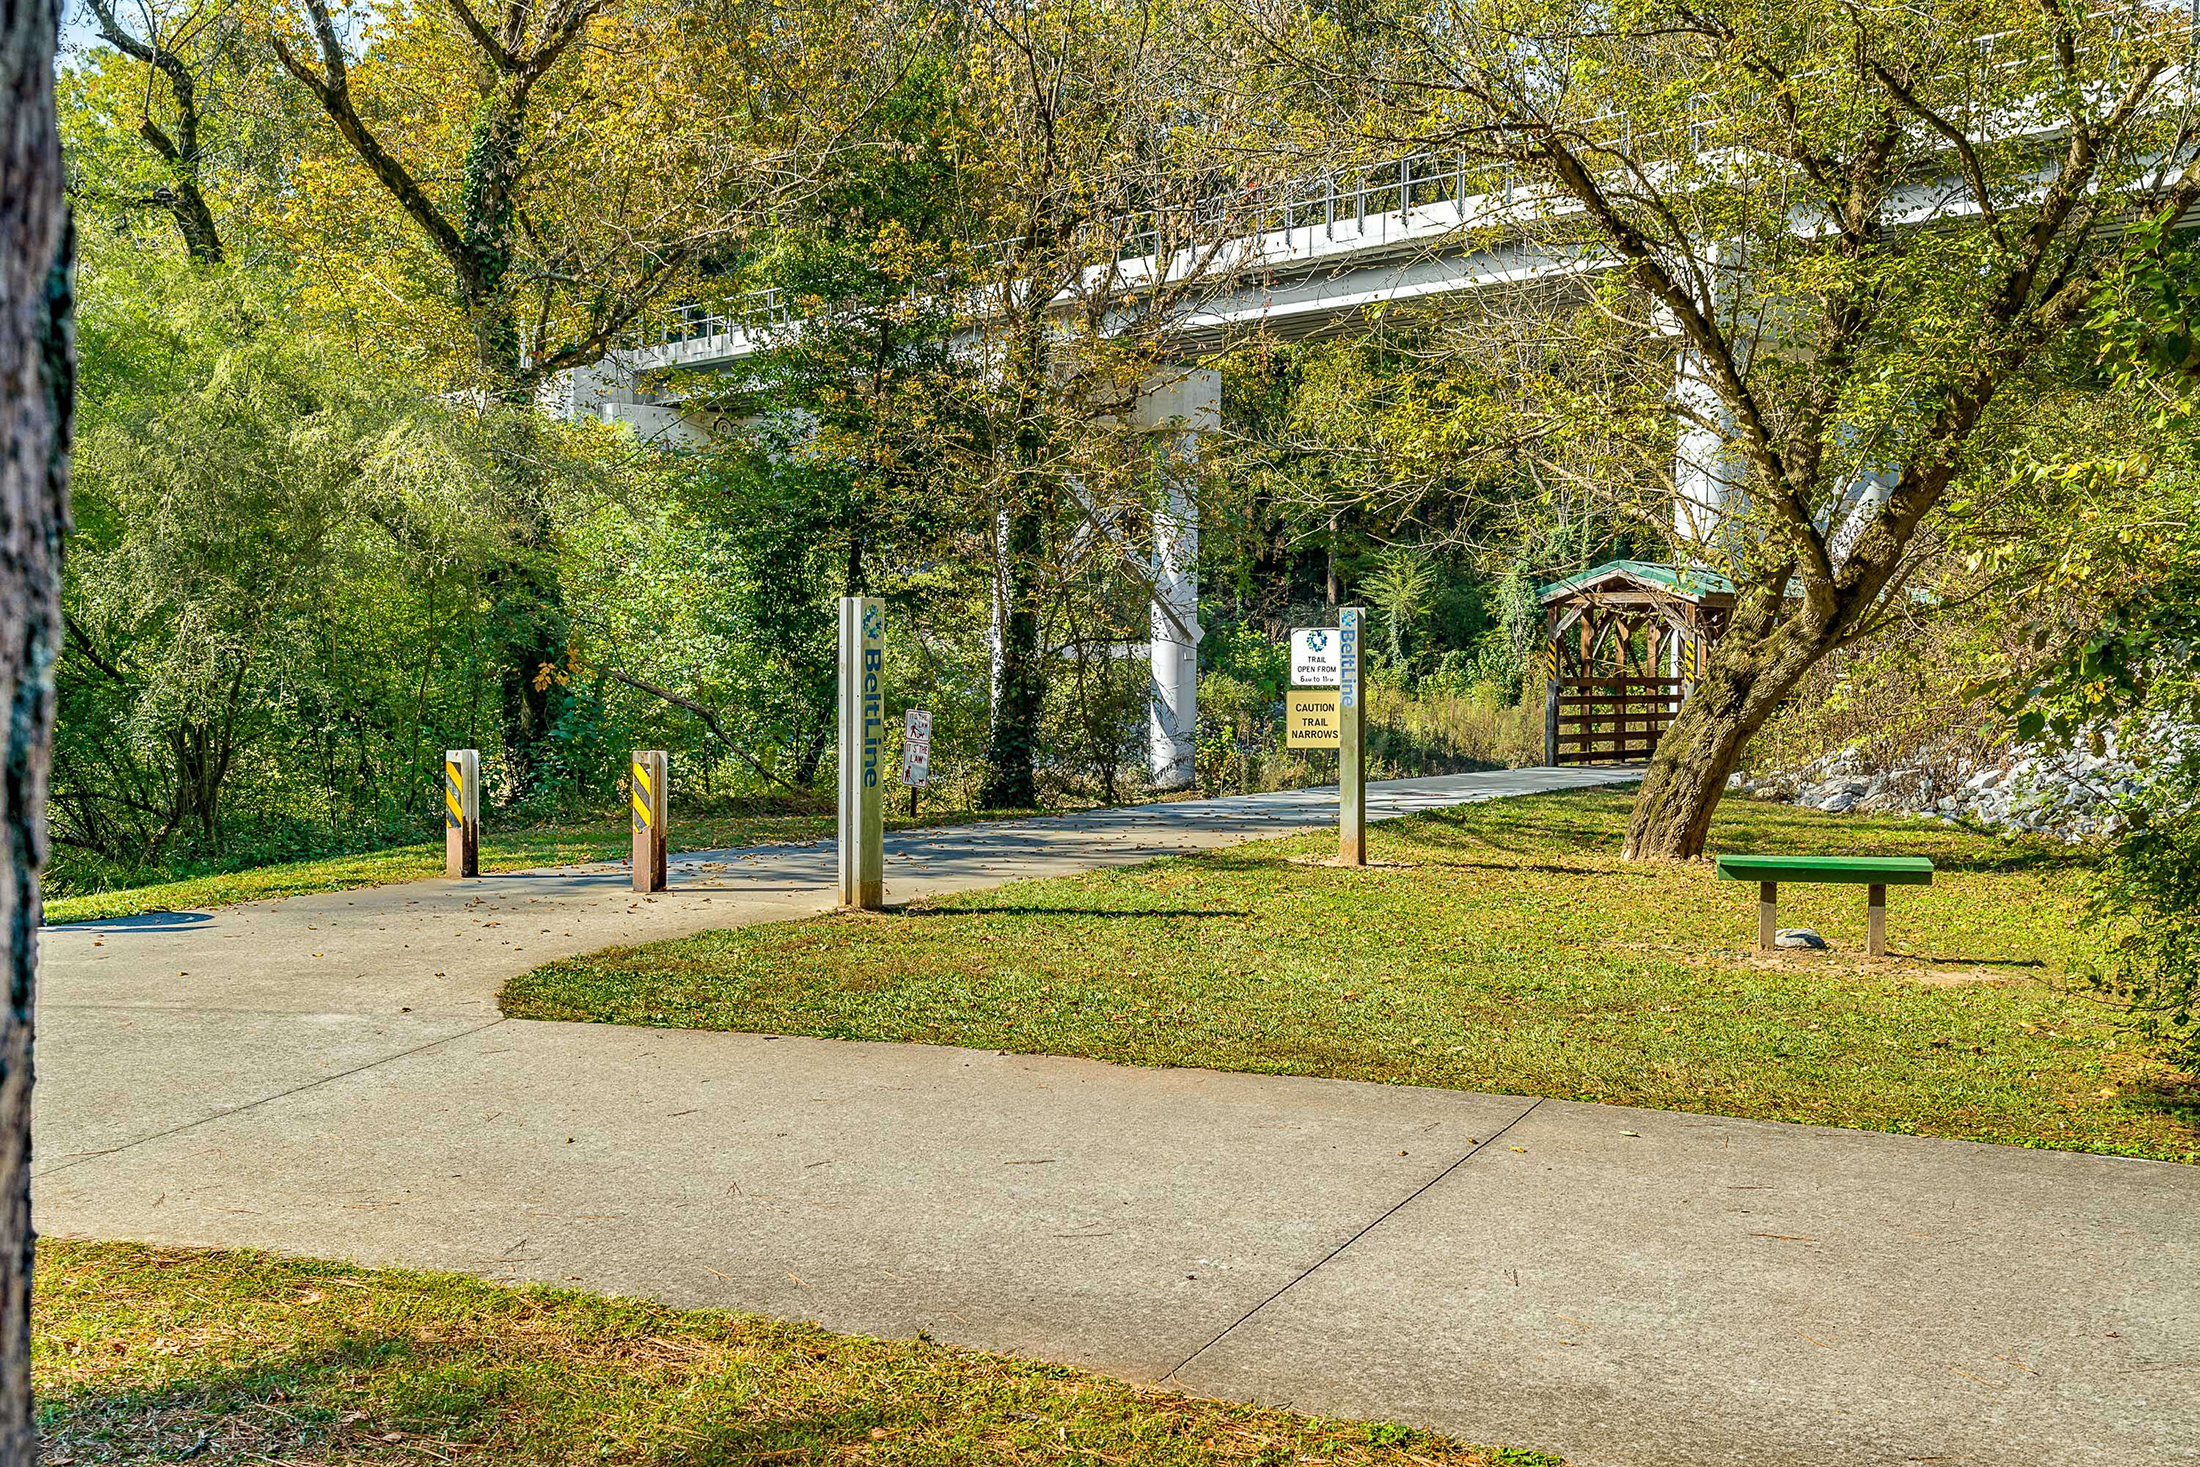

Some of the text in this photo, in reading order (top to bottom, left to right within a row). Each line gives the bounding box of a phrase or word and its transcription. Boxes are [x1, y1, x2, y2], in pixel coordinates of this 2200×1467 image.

[1297, 665, 1337, 673] OPEN FROM
[1340, 630, 1356, 707] BeltLine
[1295, 703, 1335, 712] CAUTION
[864, 648, 882, 788] BeltLine
[1302, 718, 1328, 726] TRAIL
[1291, 730, 1339, 739] NARROWS
[918, 745, 928, 754] THE
[909, 754, 924, 763] LAW
